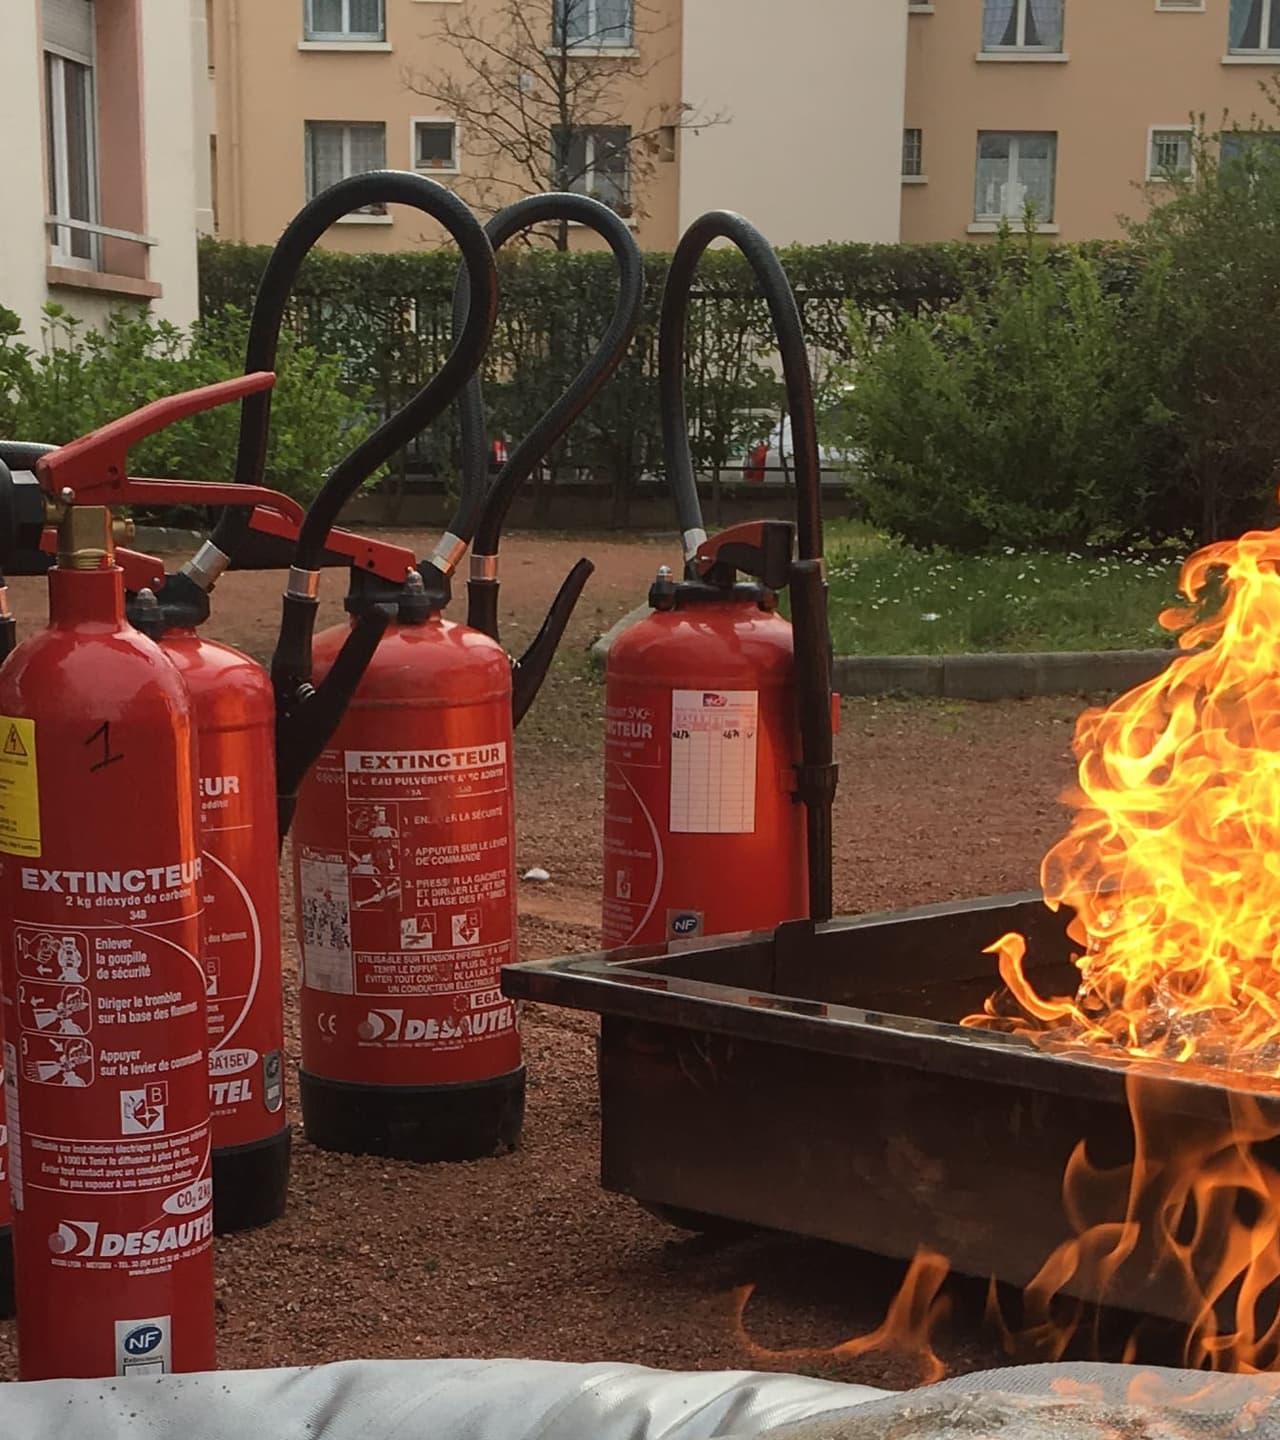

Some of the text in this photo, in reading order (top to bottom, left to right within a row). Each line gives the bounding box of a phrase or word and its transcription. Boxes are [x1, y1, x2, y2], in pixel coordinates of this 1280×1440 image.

[84, 721, 124, 772] 1
[360, 747, 500, 769] EXTINCTEUR
[199, 775, 239, 796] UR
[416, 845, 460, 857] APPUYER
[21, 857, 203, 894] EXTINCTEUR
[65, 893, 157, 908] 2 kg dioxyde de
[674, 918, 696, 931] NF
[95, 937, 132, 951] Enlever
[98, 997, 131, 1013] Diriger
[404, 1006, 514, 1041] DESAUTEL
[99, 1049, 141, 1064] Appuyer
[150, 1087, 164, 1103] B
[128, 1330, 160, 1351] NF
